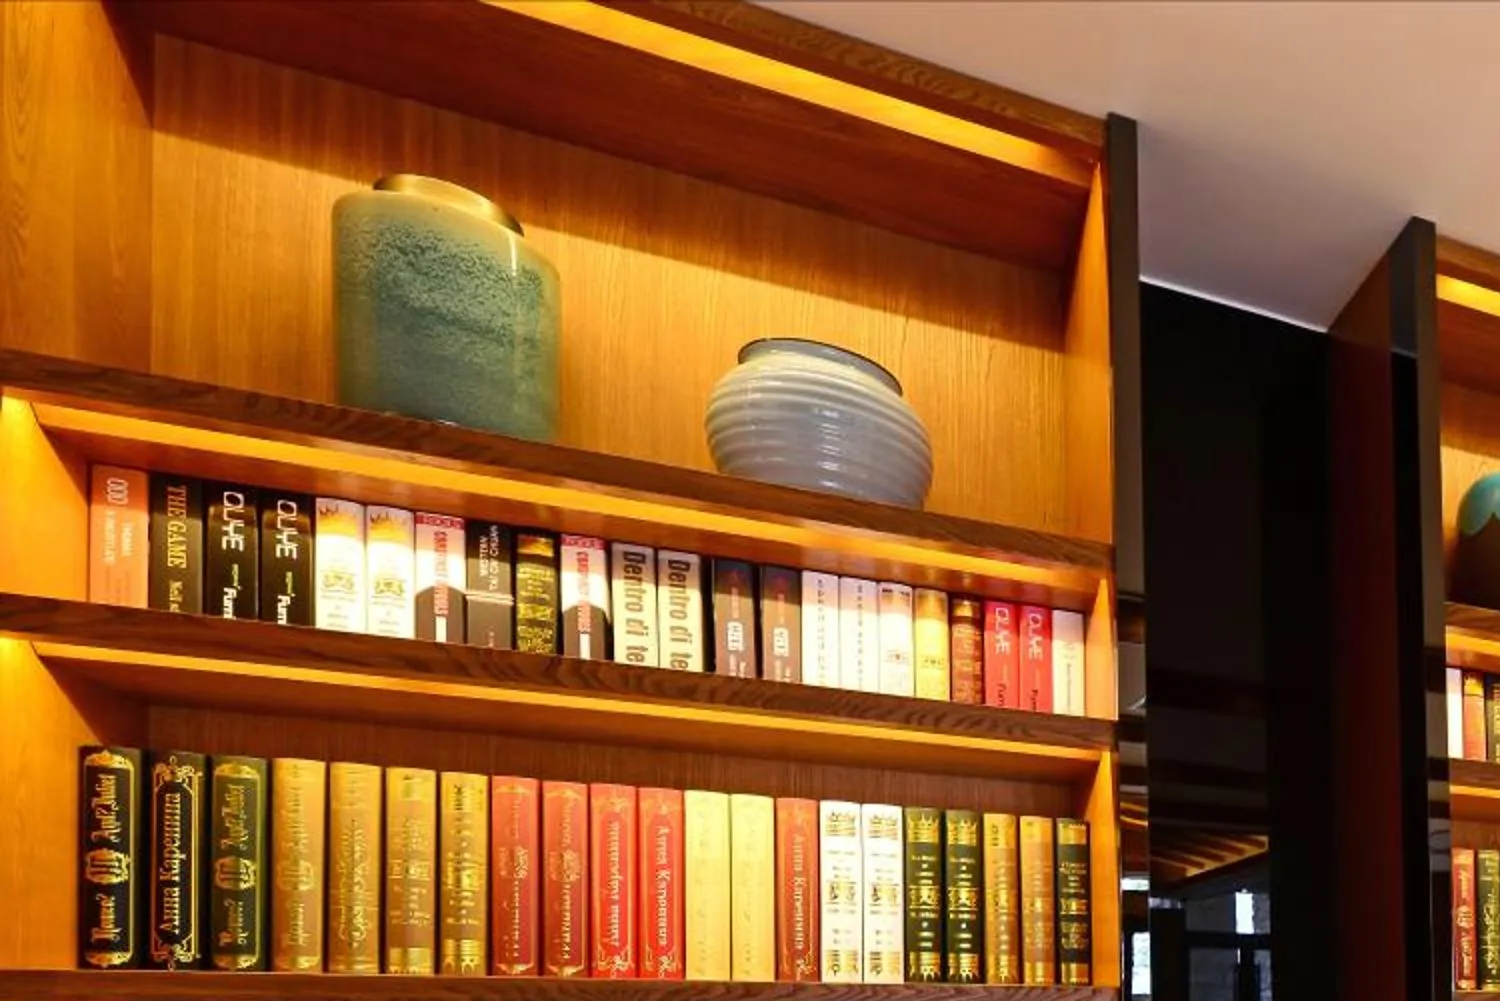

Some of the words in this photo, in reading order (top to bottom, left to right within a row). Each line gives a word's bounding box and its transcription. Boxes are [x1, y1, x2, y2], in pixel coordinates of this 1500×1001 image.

[167, 520, 188, 569] GAME
[623, 551, 647, 612] Dentro
[668, 559, 691, 620] Dentro
[626, 618, 650, 637] di
[671, 625, 692, 645] di
[626, 645, 649, 663] te
[671, 653, 693, 670] te
[158, 792, 187, 883] Каренина
[158, 887, 181, 936] Анна
